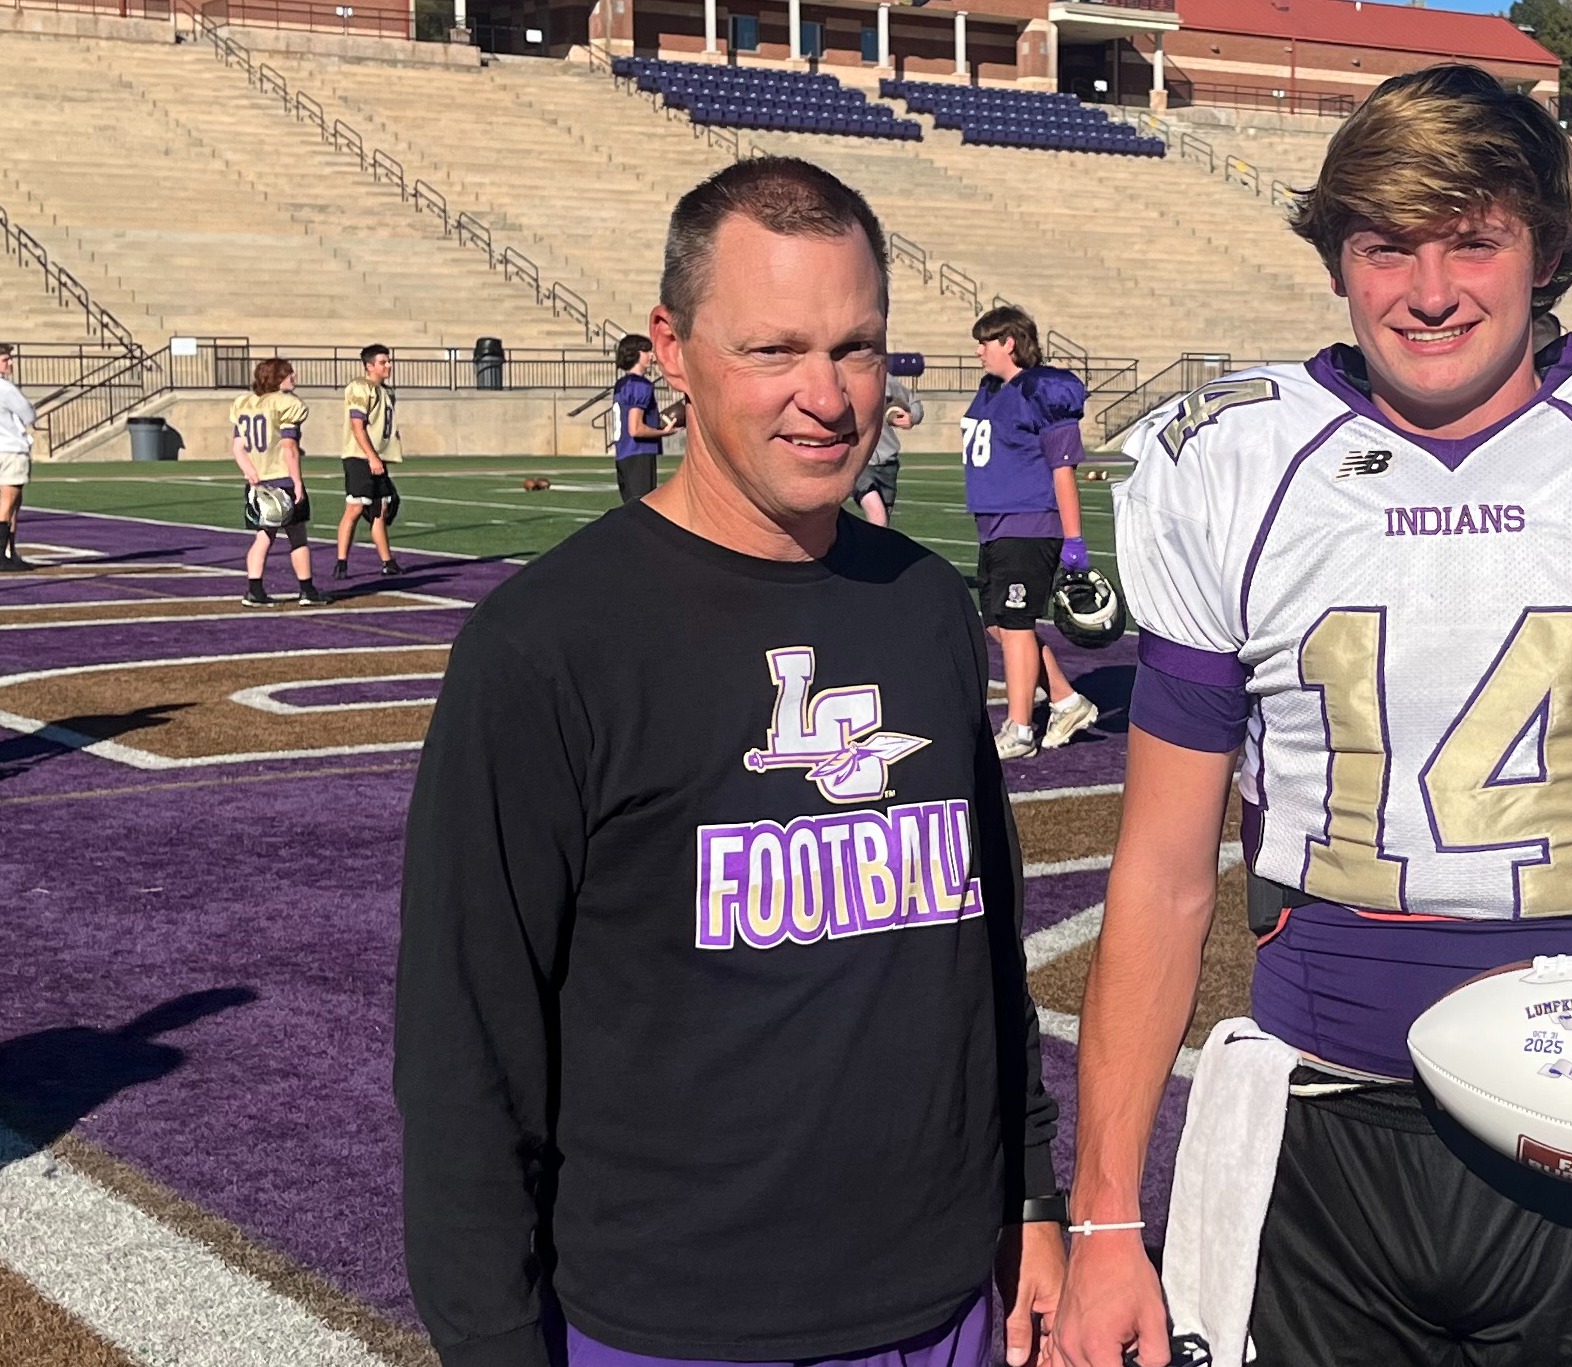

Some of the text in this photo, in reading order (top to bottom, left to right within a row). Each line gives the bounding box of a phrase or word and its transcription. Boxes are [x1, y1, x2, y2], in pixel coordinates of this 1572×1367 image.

[238, 414, 267, 452] 30
[960, 417, 992, 467] 78
[1384, 504, 1526, 536] INDIANS
[766, 646, 883, 804] LC
[699, 802, 983, 947] FOOTBALL
[1523, 1038, 1565, 1055] 2025
